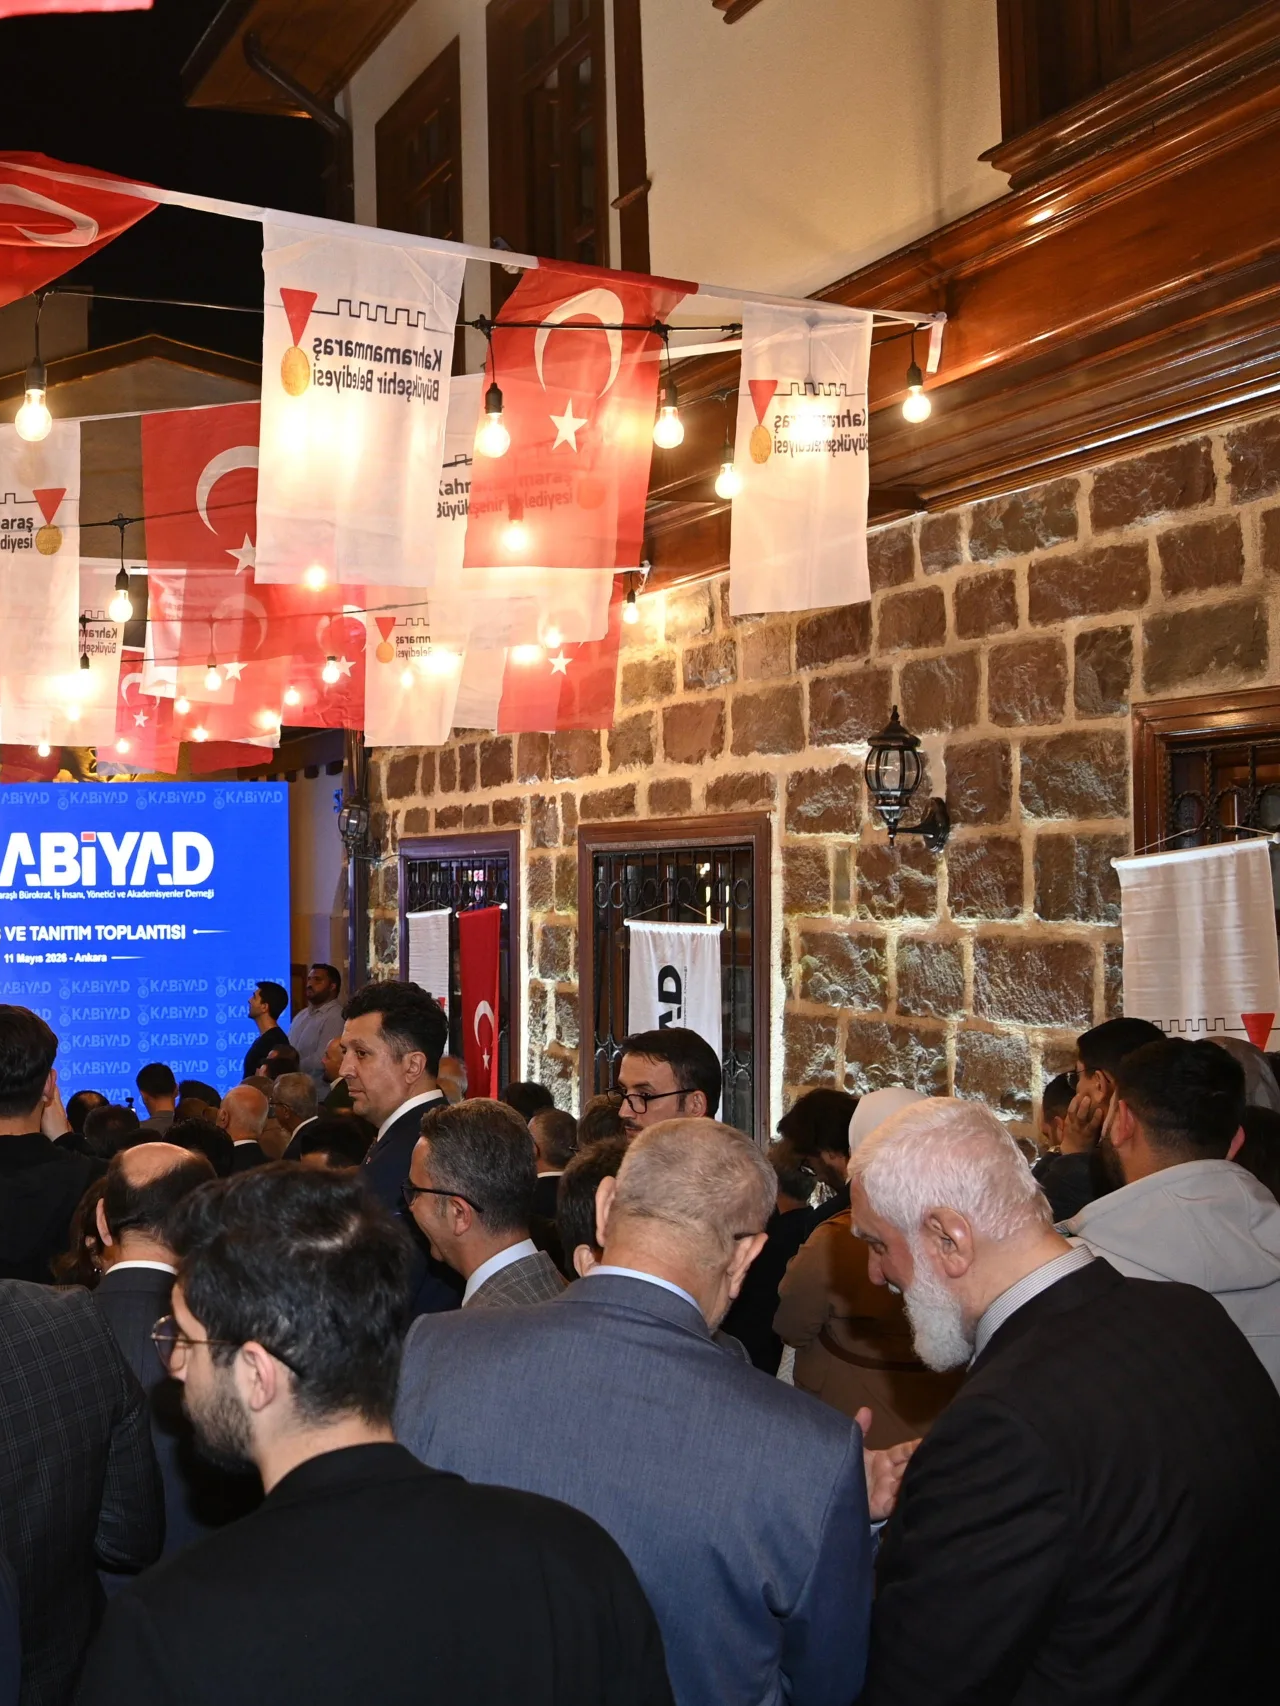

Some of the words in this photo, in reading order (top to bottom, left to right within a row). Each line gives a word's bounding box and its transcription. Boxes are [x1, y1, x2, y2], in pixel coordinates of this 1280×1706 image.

[18, 890, 53, 900] Bürokrat,
[86, 889, 116, 899] Yönetici
[127, 889, 184, 900] Akademisyenler
[185, 889, 215, 900] Derneği
[4, 926, 27, 941] VE
[29, 925, 92, 941] TANITIM
[94, 924, 186, 940] TOPLANTISI
[4, 953, 14, 963] 11
[16, 953, 44, 965] Mayıs
[74, 952, 108, 963] Ankara
